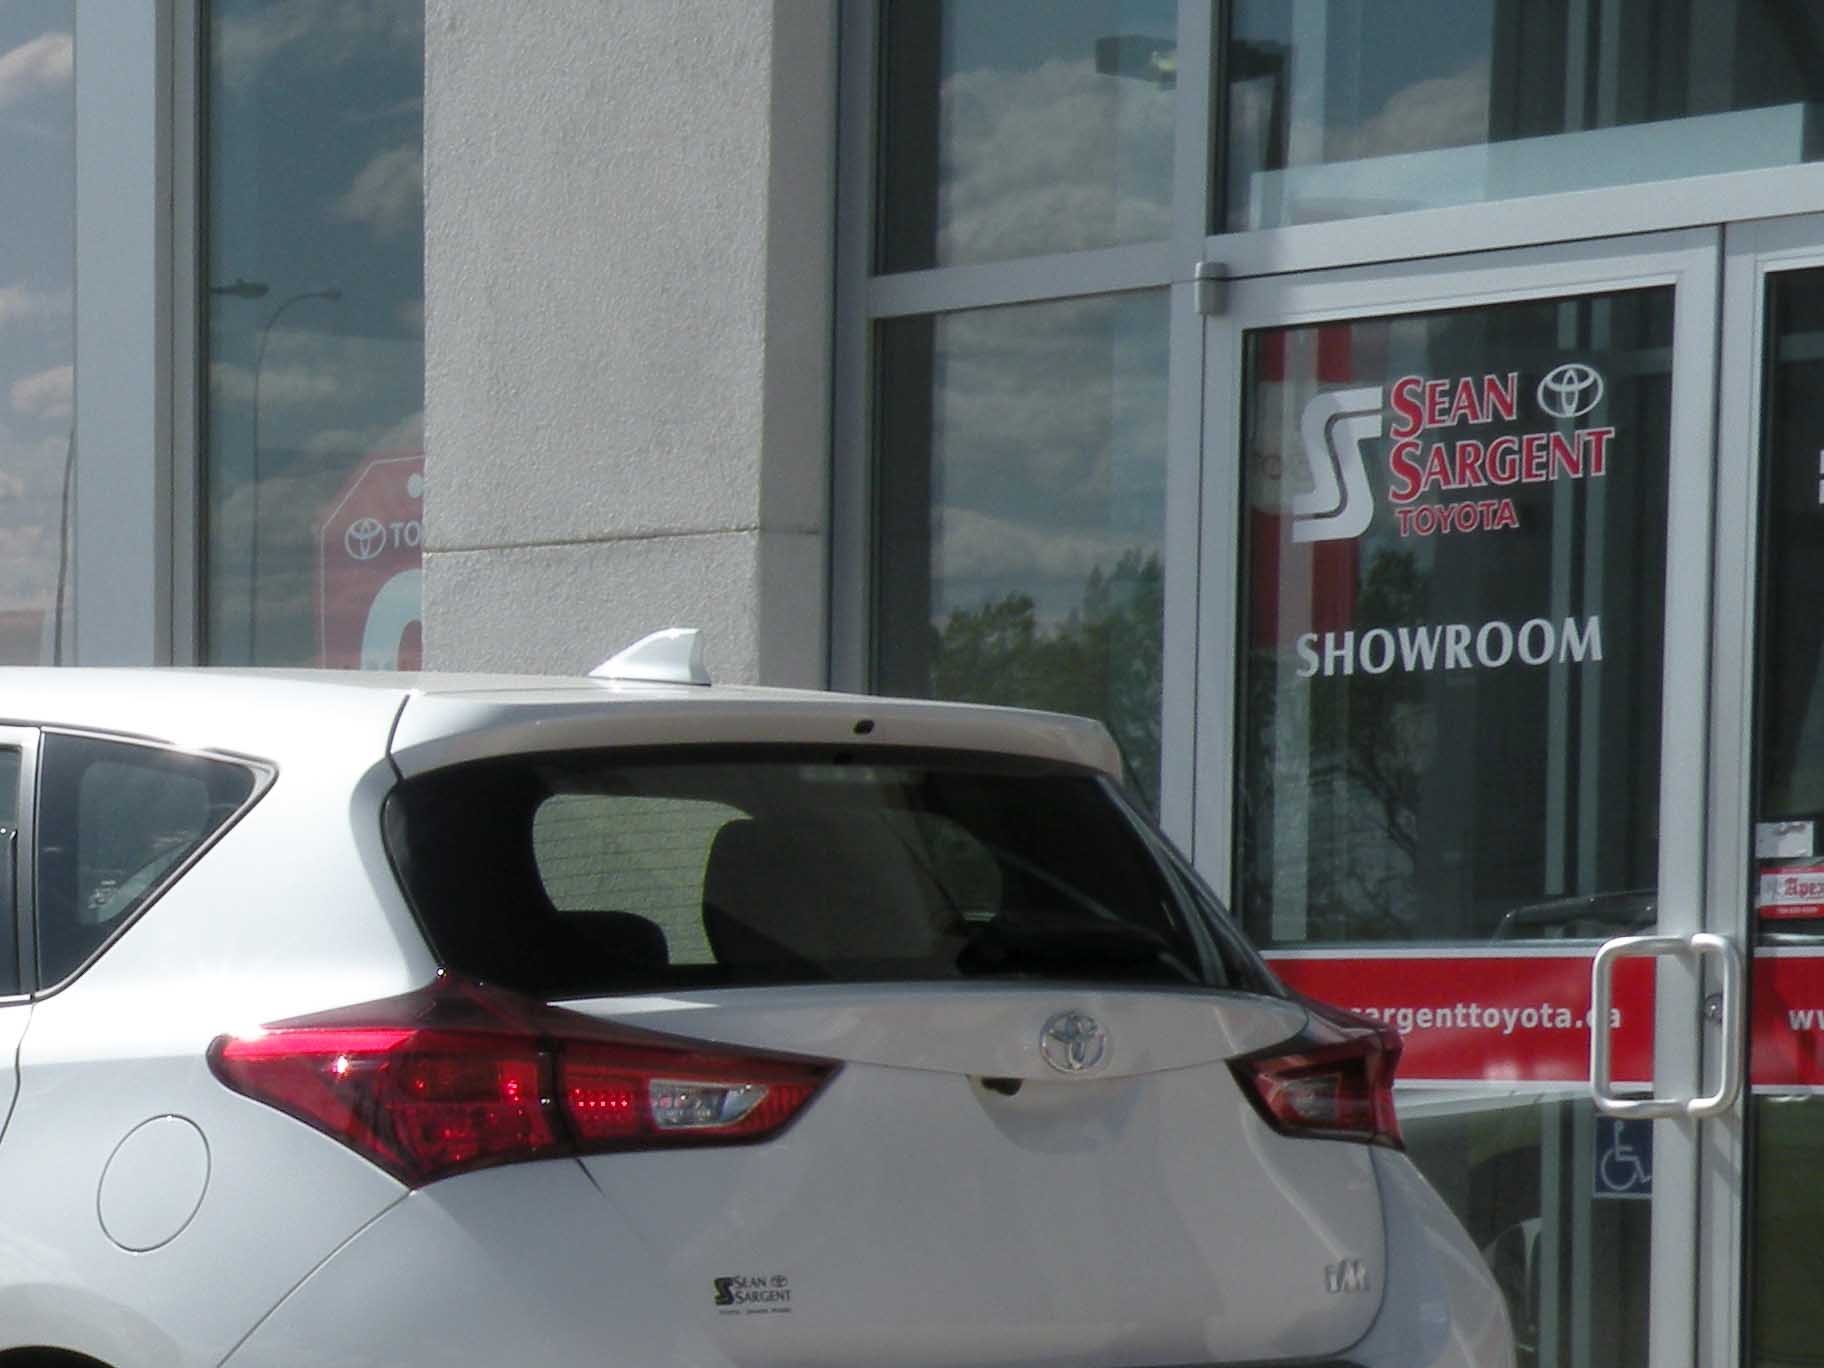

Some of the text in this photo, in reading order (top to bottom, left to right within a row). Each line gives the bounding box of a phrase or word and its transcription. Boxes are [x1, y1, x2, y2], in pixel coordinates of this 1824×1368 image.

[1389, 372, 1519, 440] SEAN
[1389, 427, 1615, 504] SARGENT
[1395, 499, 1520, 537] TOYOTA
[1295, 615, 1603, 678] SHOWROOM
[736, 1289, 791, 1304] SARGENT
